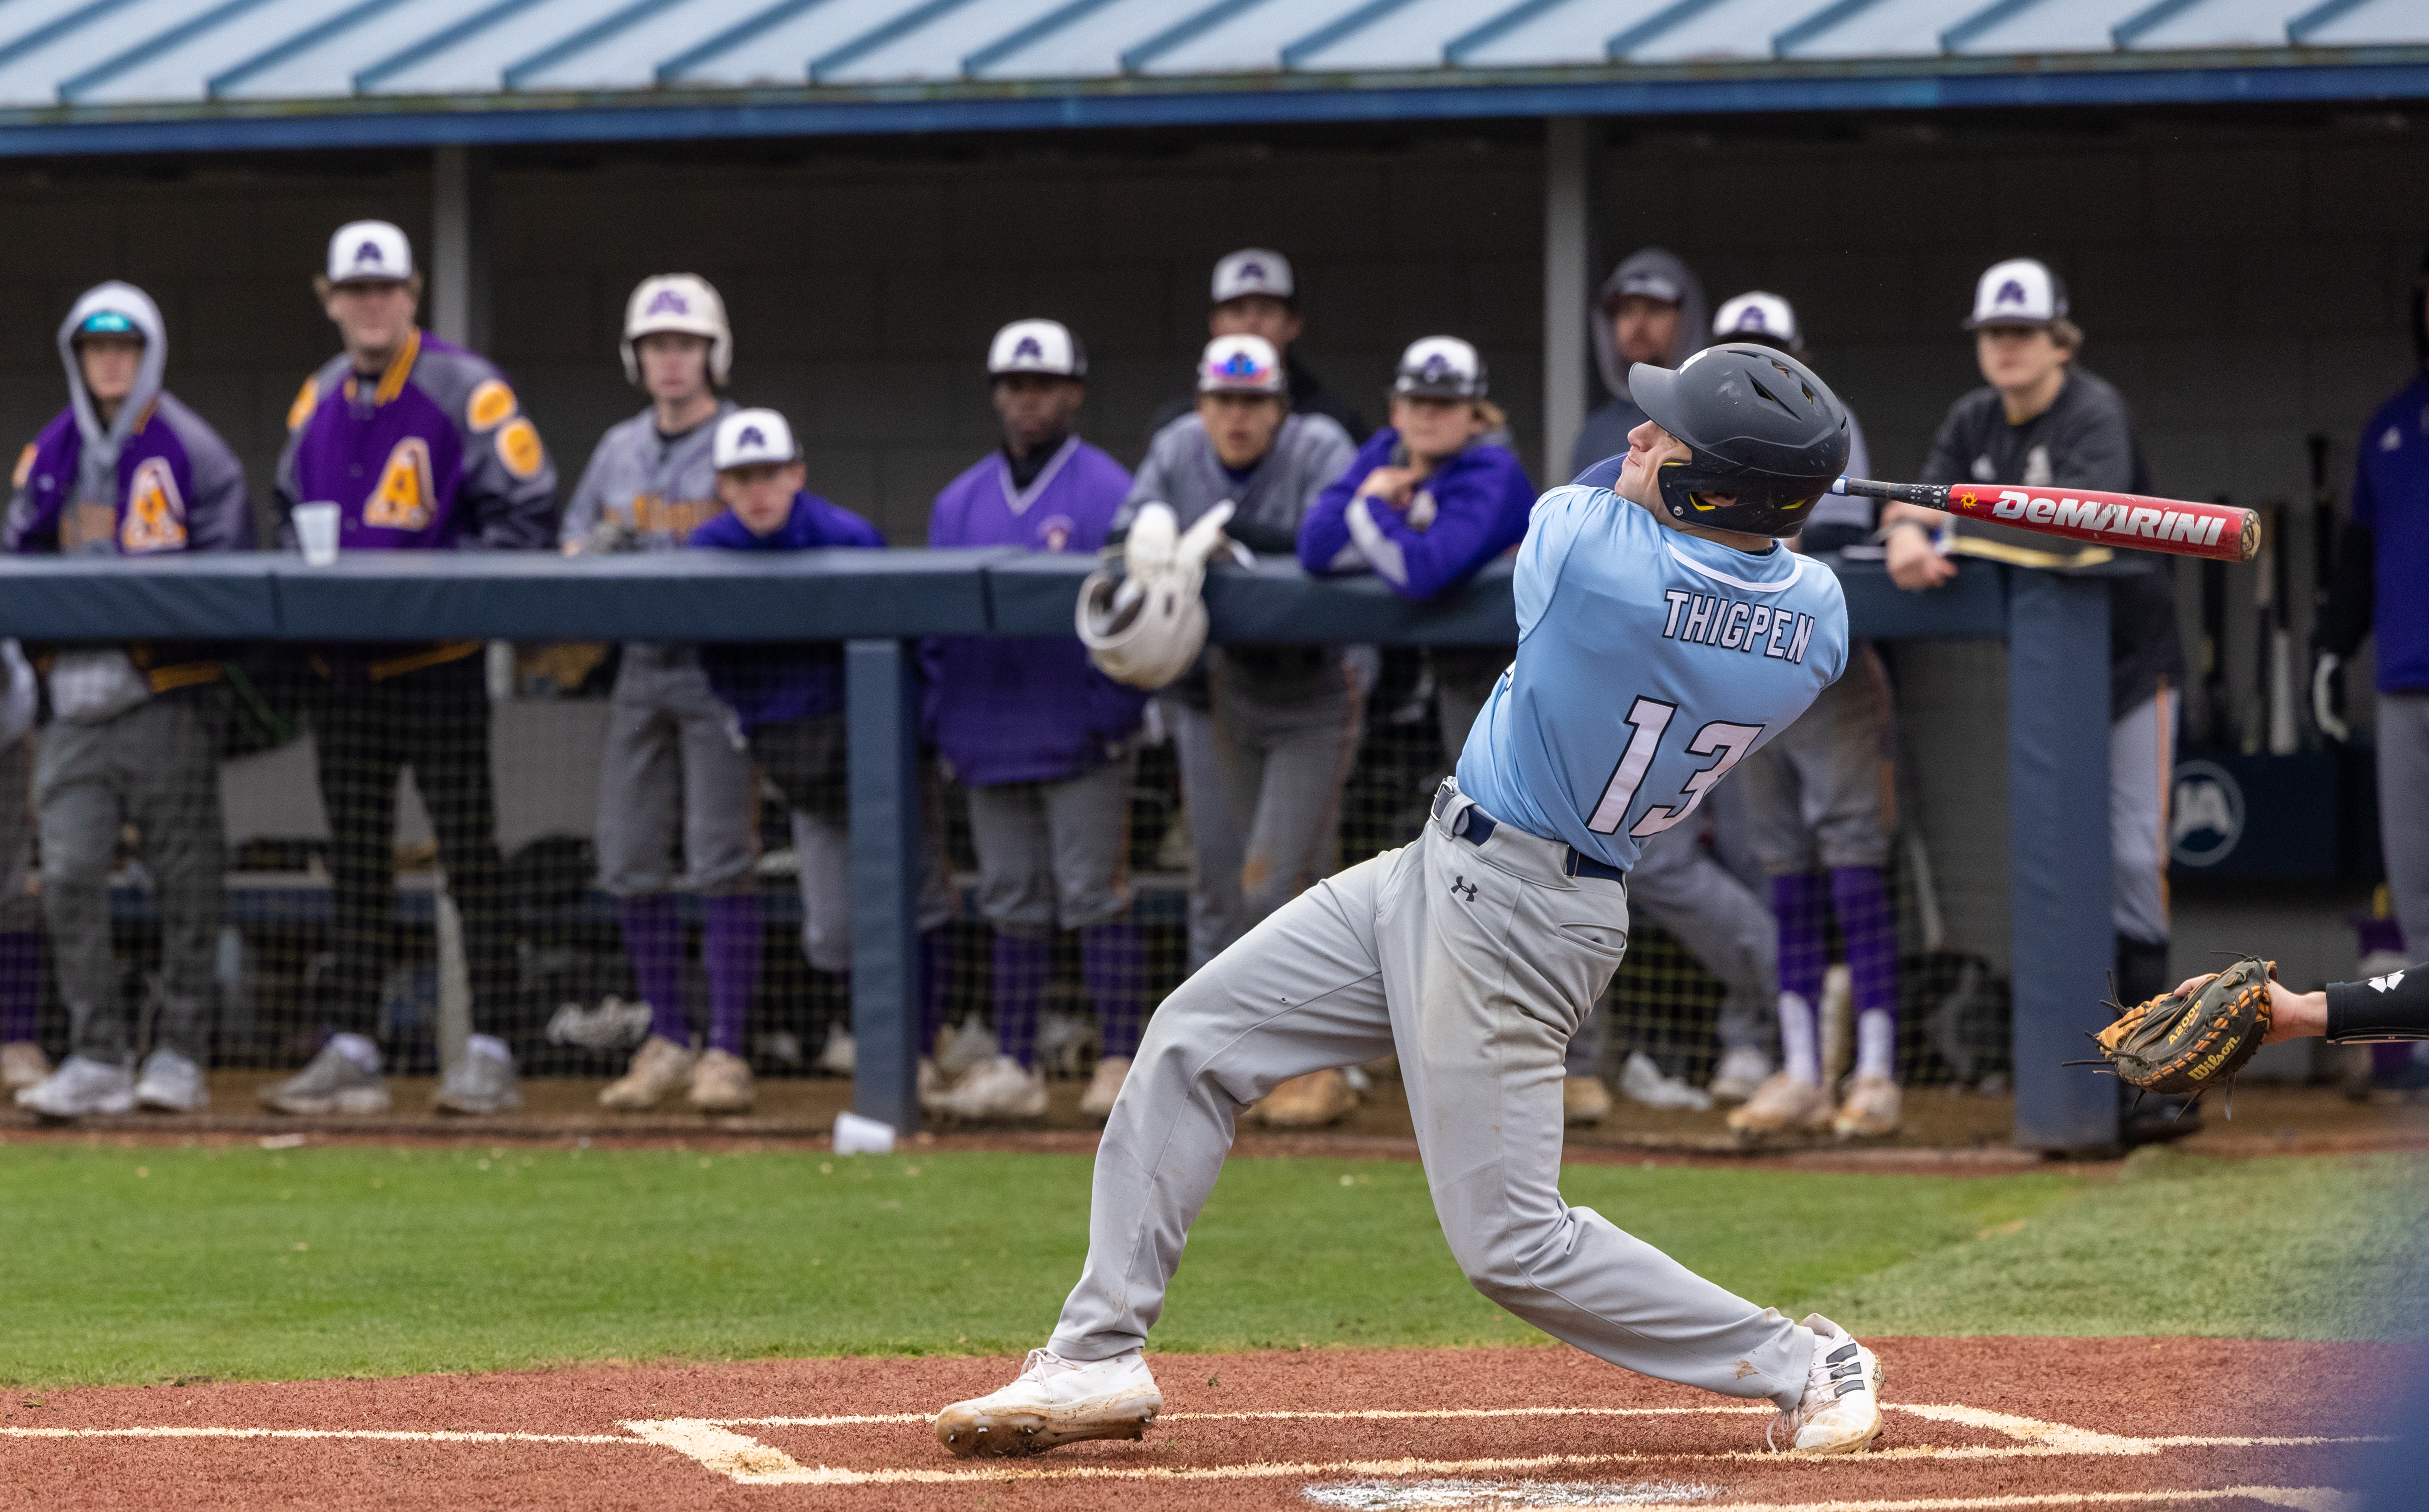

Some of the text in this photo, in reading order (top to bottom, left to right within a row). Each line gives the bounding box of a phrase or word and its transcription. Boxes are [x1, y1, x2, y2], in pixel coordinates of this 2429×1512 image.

[121, 455, 188, 549] A
[362, 436, 439, 531] A
[1662, 589, 1815, 664] THIGPEN
[1587, 695, 1766, 838] 13
[2168, 999, 2202, 1045] A2000
[2188, 1037, 2239, 1080] Wilson
